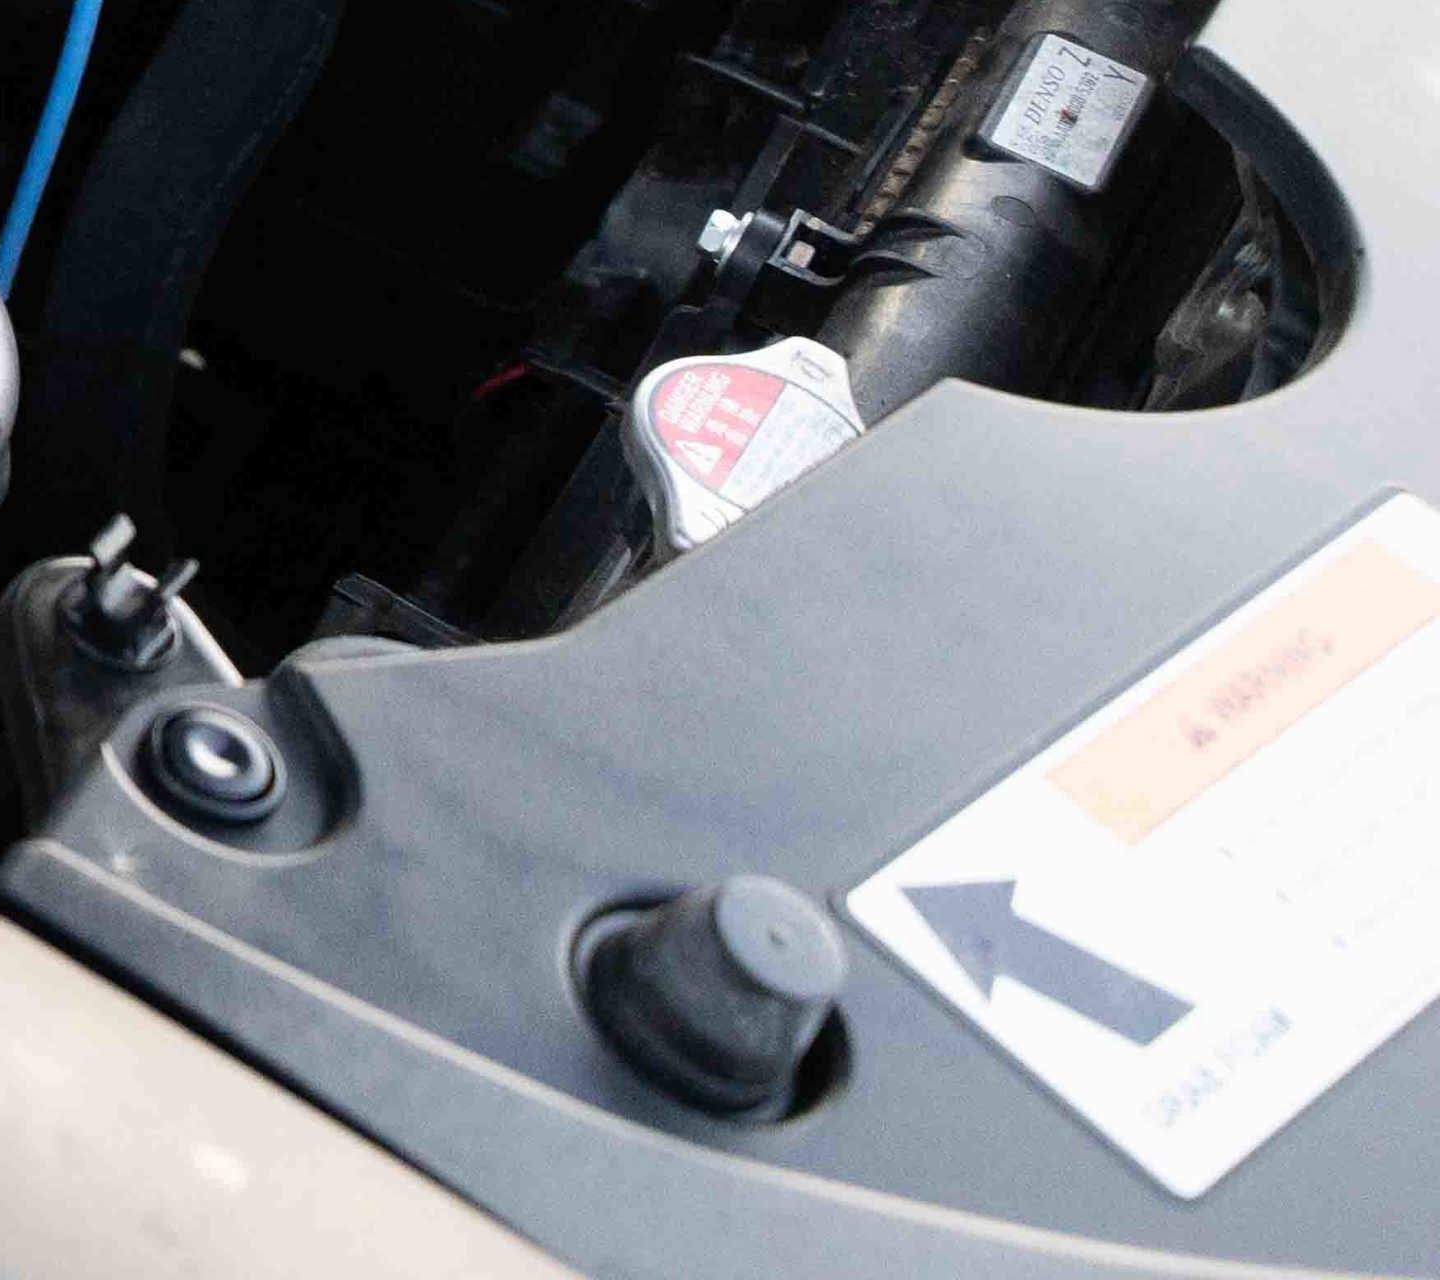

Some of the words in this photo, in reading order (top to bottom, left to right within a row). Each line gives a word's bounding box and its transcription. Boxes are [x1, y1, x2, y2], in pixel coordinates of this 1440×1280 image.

[1057, 47, 1093, 67] Z
[1104, 65, 1137, 85] Y
[1024, 65, 1066, 125] DENSO
